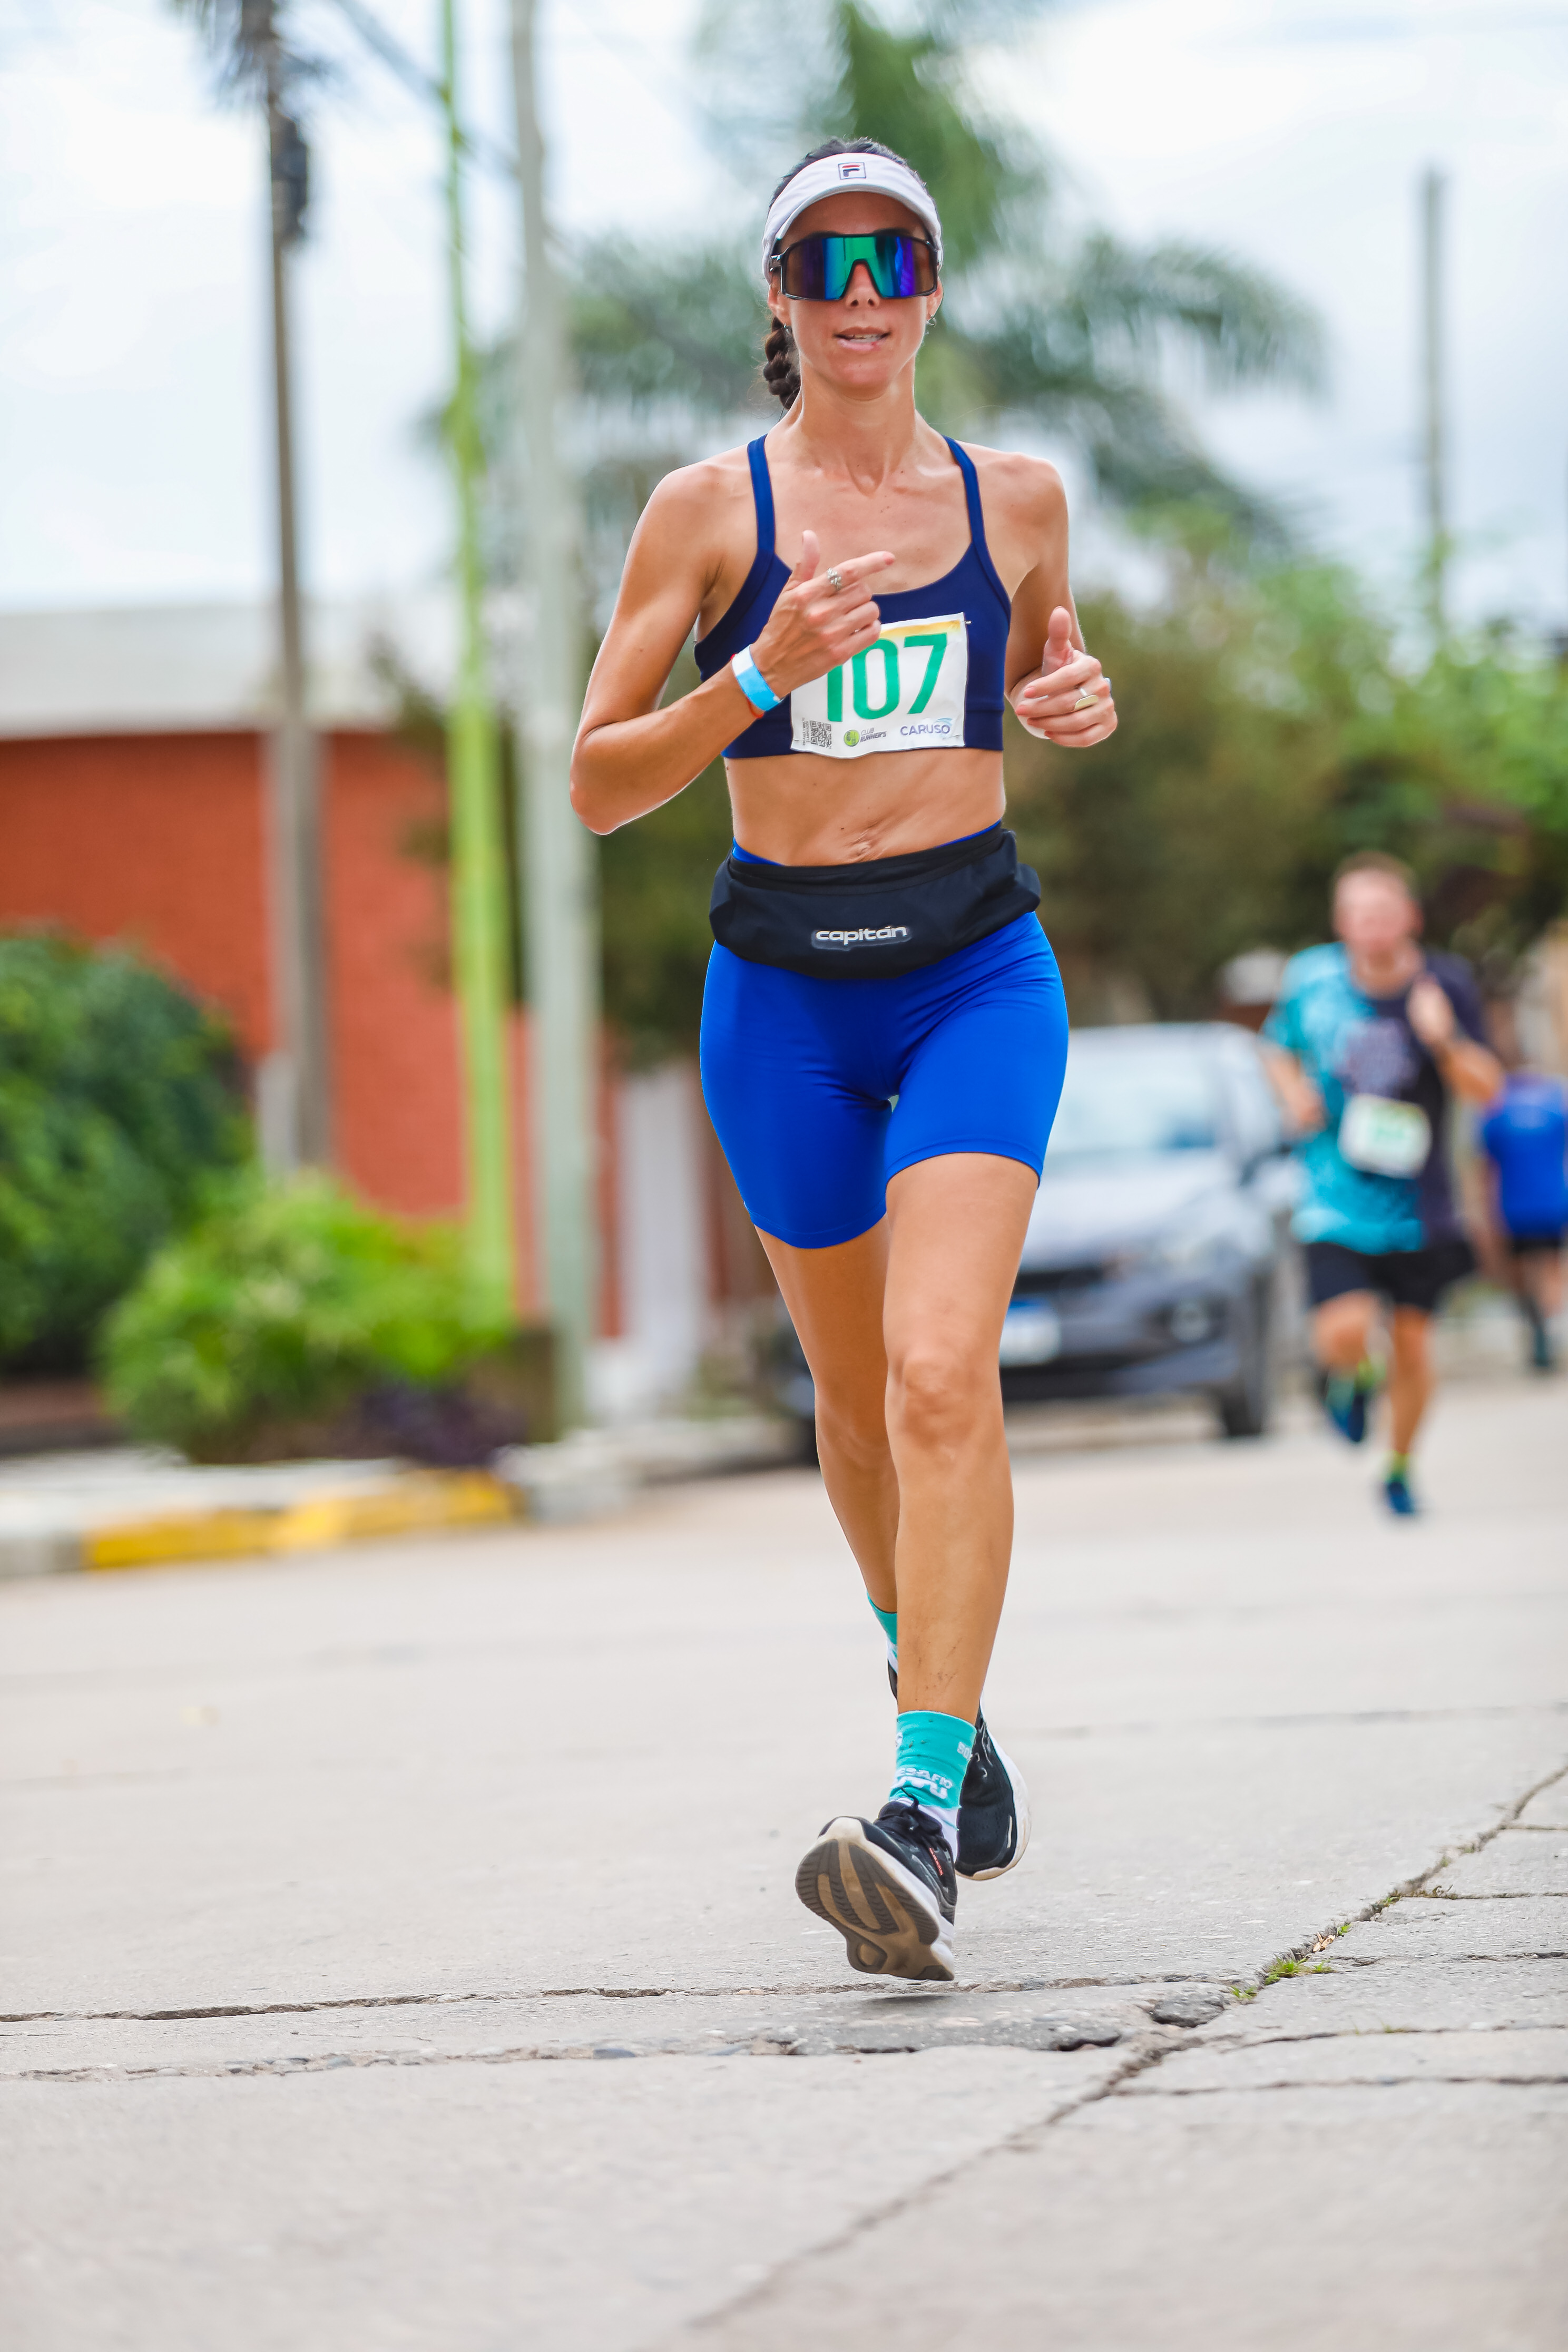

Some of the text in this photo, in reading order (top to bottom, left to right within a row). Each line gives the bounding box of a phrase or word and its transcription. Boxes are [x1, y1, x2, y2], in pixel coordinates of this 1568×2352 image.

[827, 633, 947, 722] 107
[861, 728, 874, 736] CLUB
[900, 724, 950, 736] CARUSO
[816, 926, 907, 946] capitán
